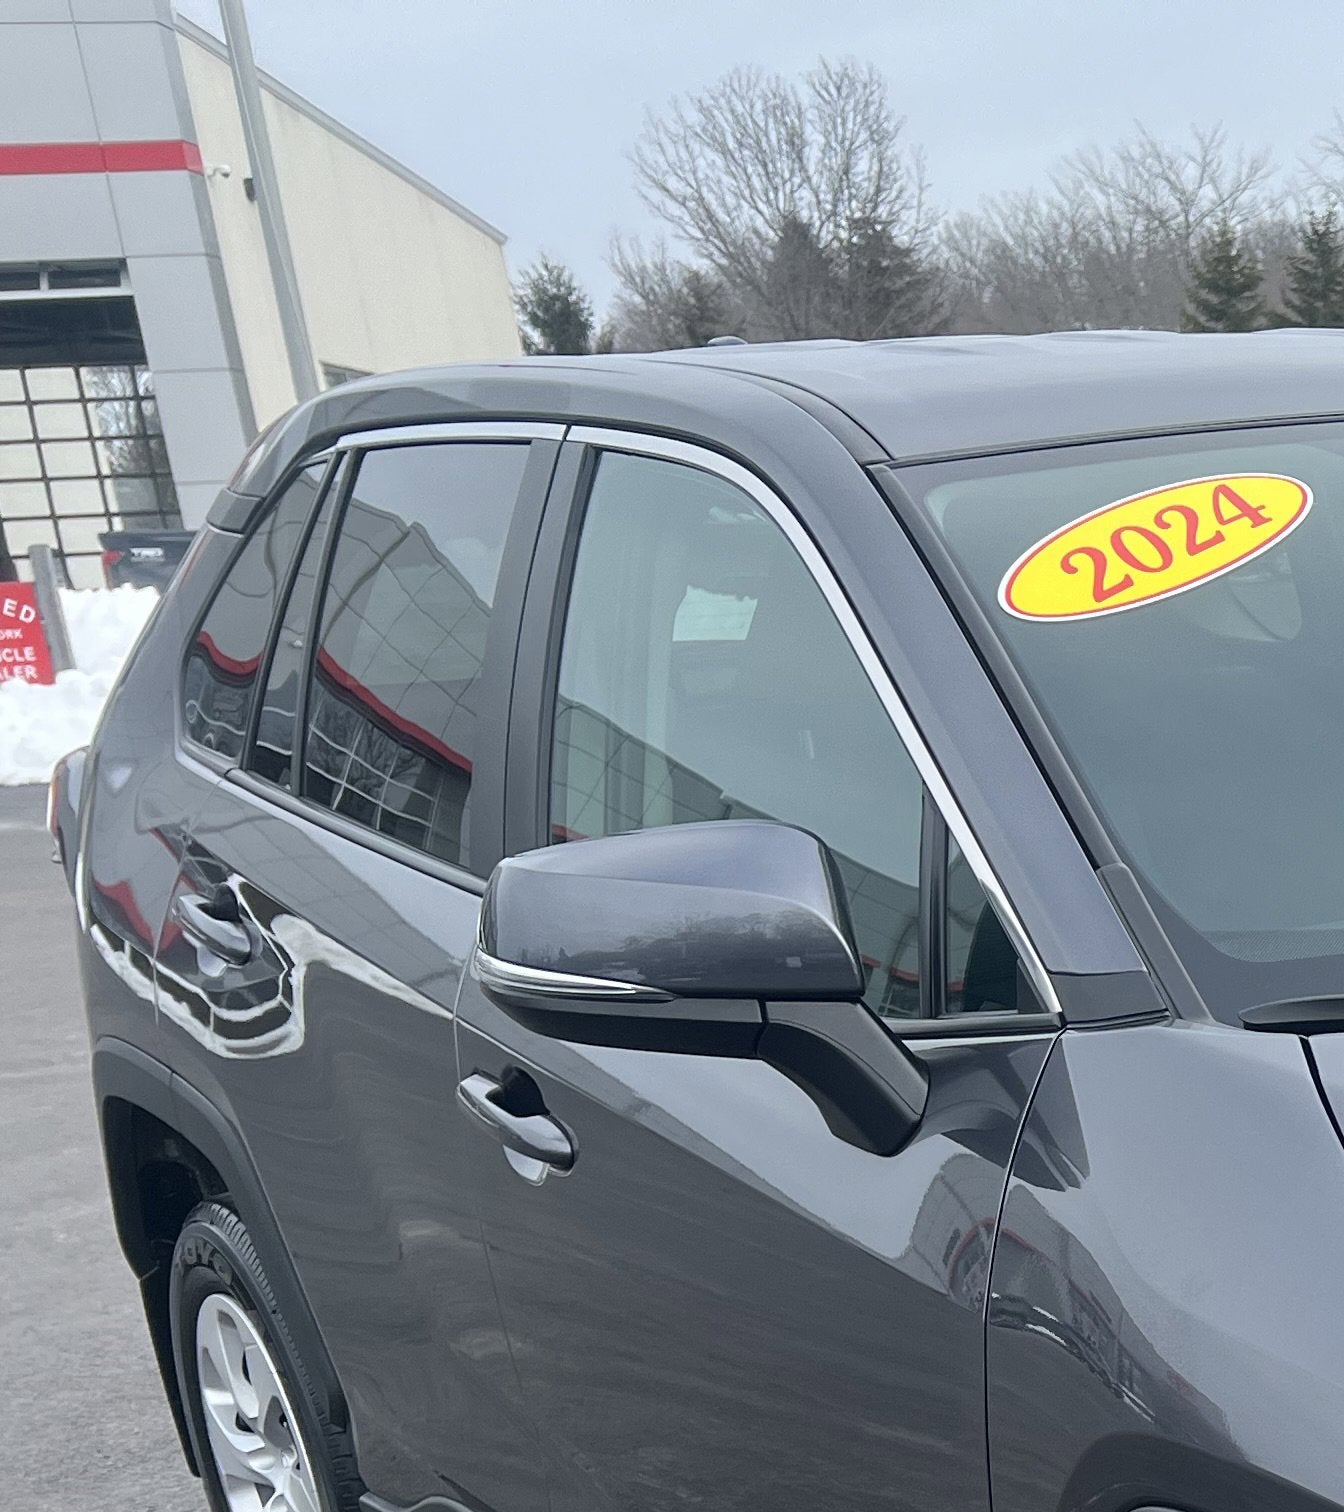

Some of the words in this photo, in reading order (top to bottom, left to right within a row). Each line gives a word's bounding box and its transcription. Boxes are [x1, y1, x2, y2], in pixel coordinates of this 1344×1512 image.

[1060, 483, 1273, 603] 2024
[0, 646, 36, 663] CLE
[0, 664, 38, 681] LER
